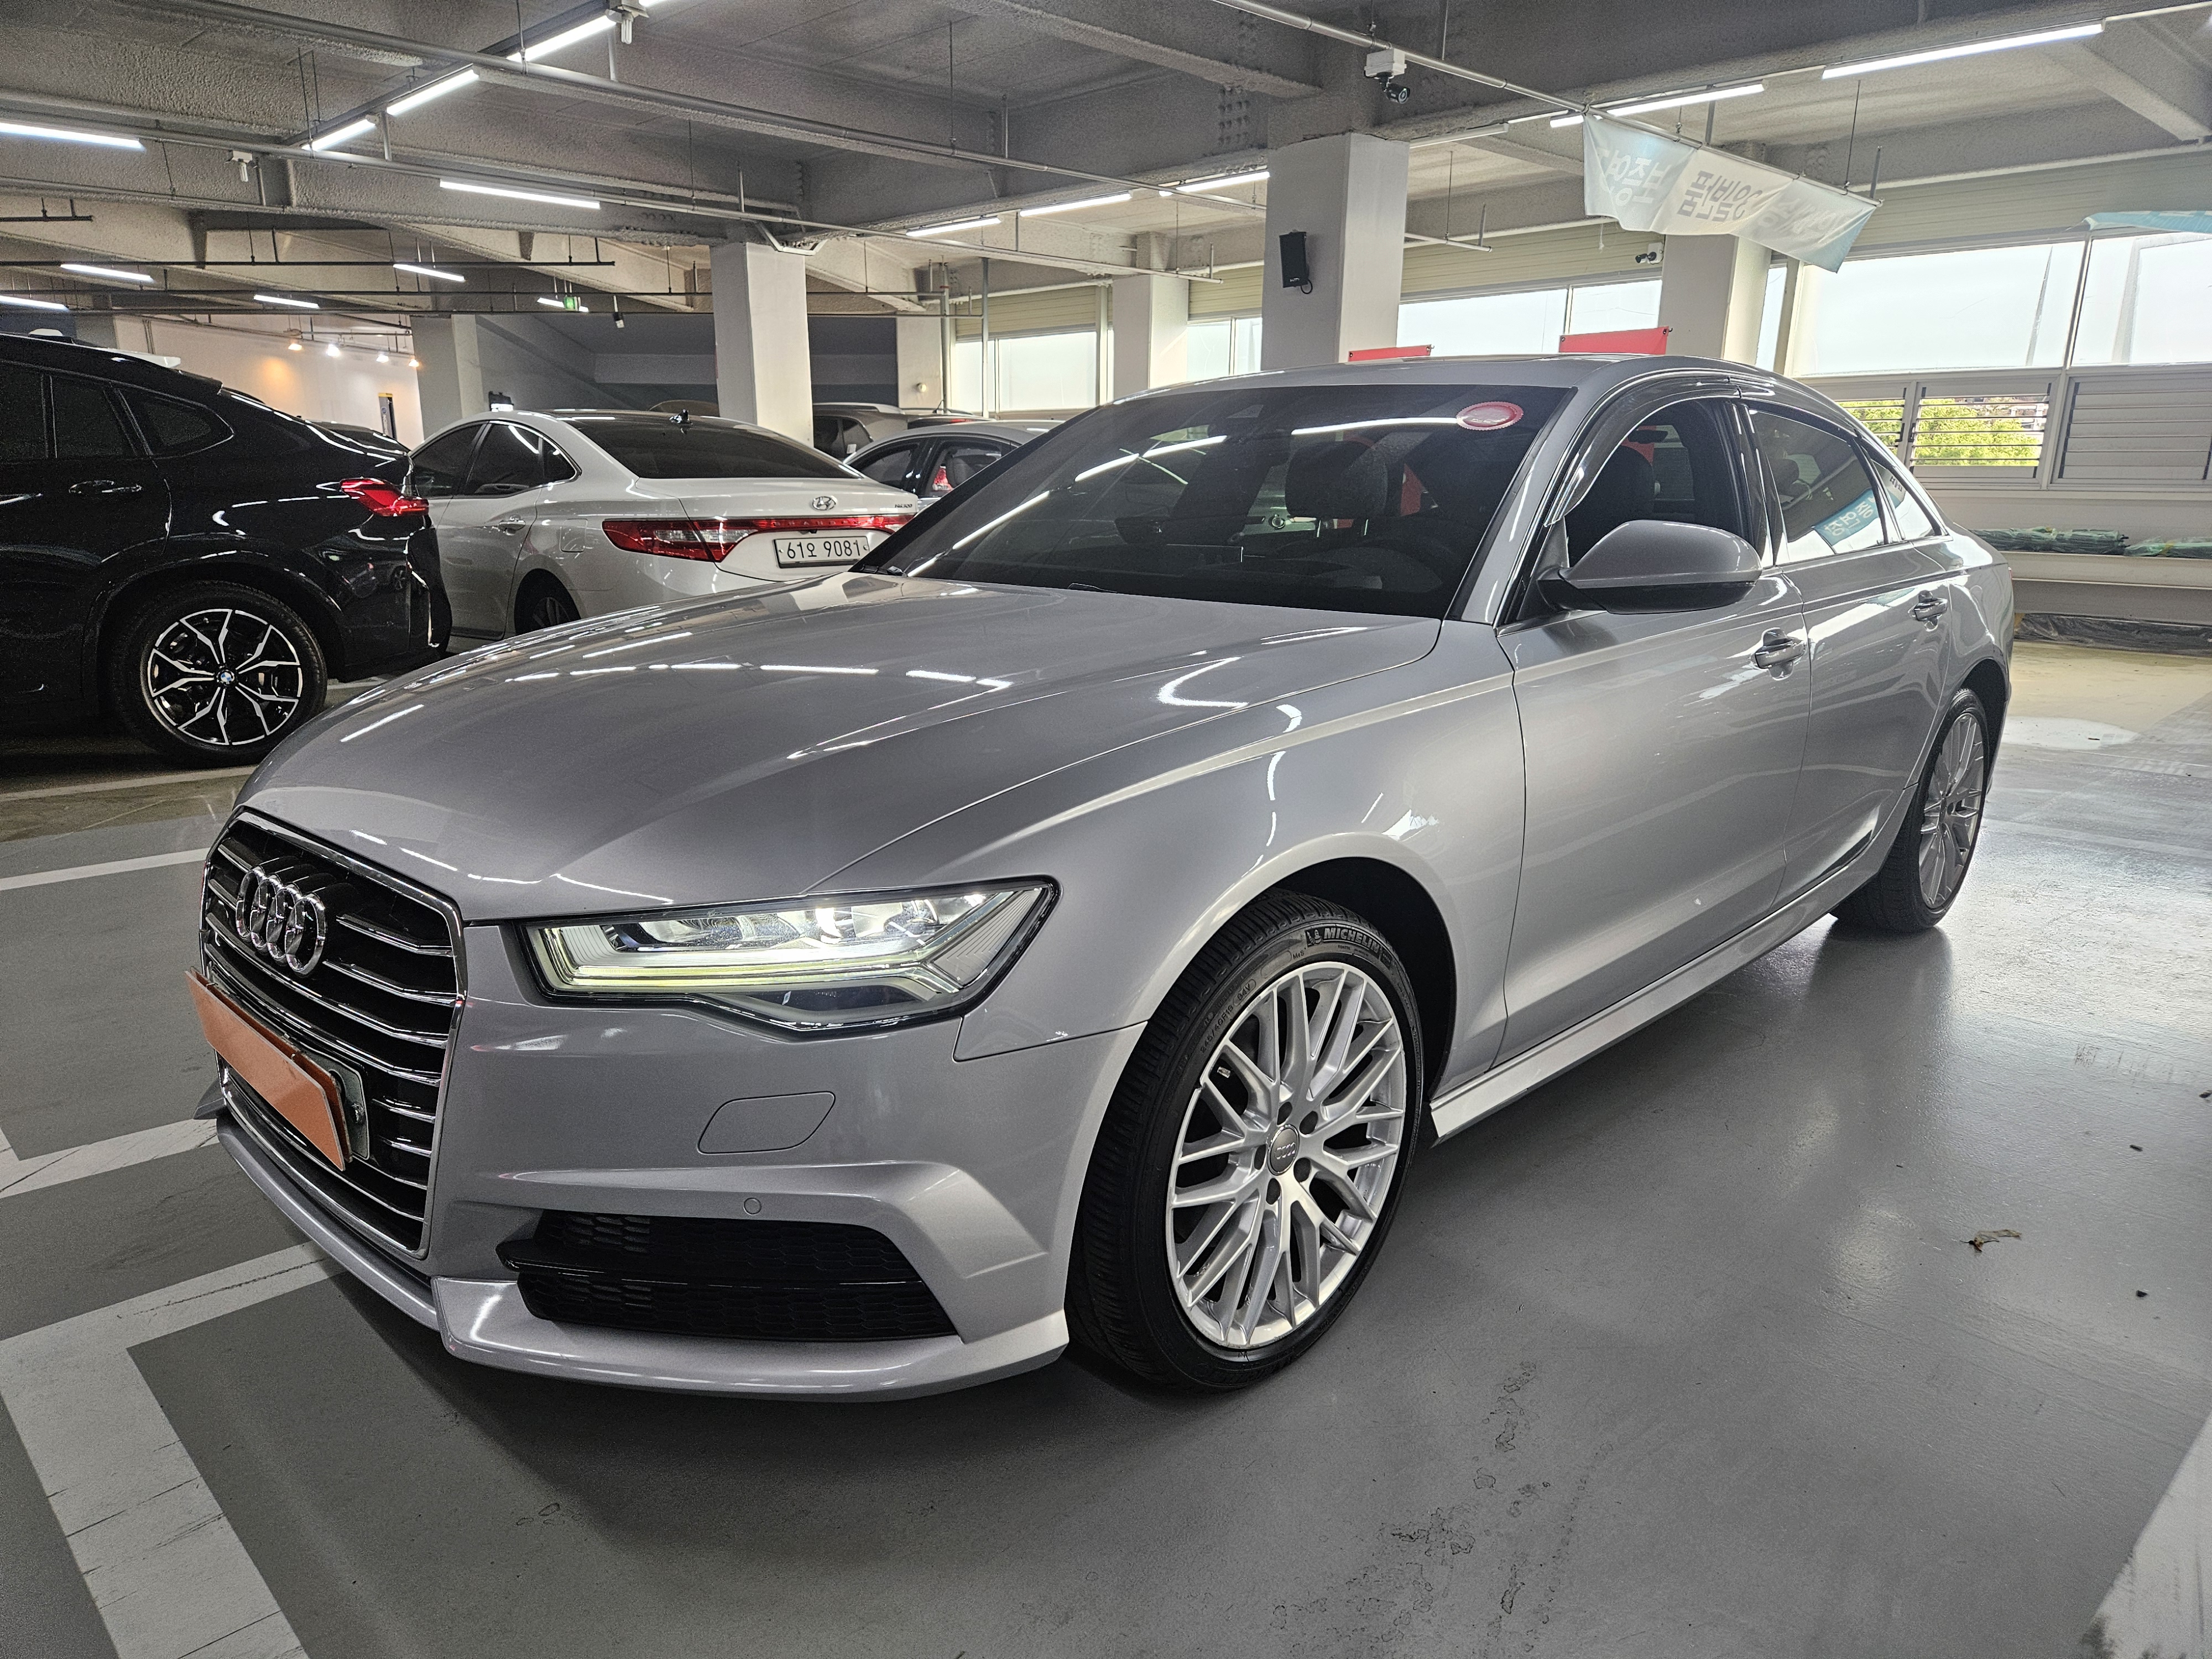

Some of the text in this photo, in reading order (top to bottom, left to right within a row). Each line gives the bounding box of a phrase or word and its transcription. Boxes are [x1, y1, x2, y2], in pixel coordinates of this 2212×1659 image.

[787, 540, 860, 559] 61오 9081
[1323, 927, 1381, 953] MICHELIN
